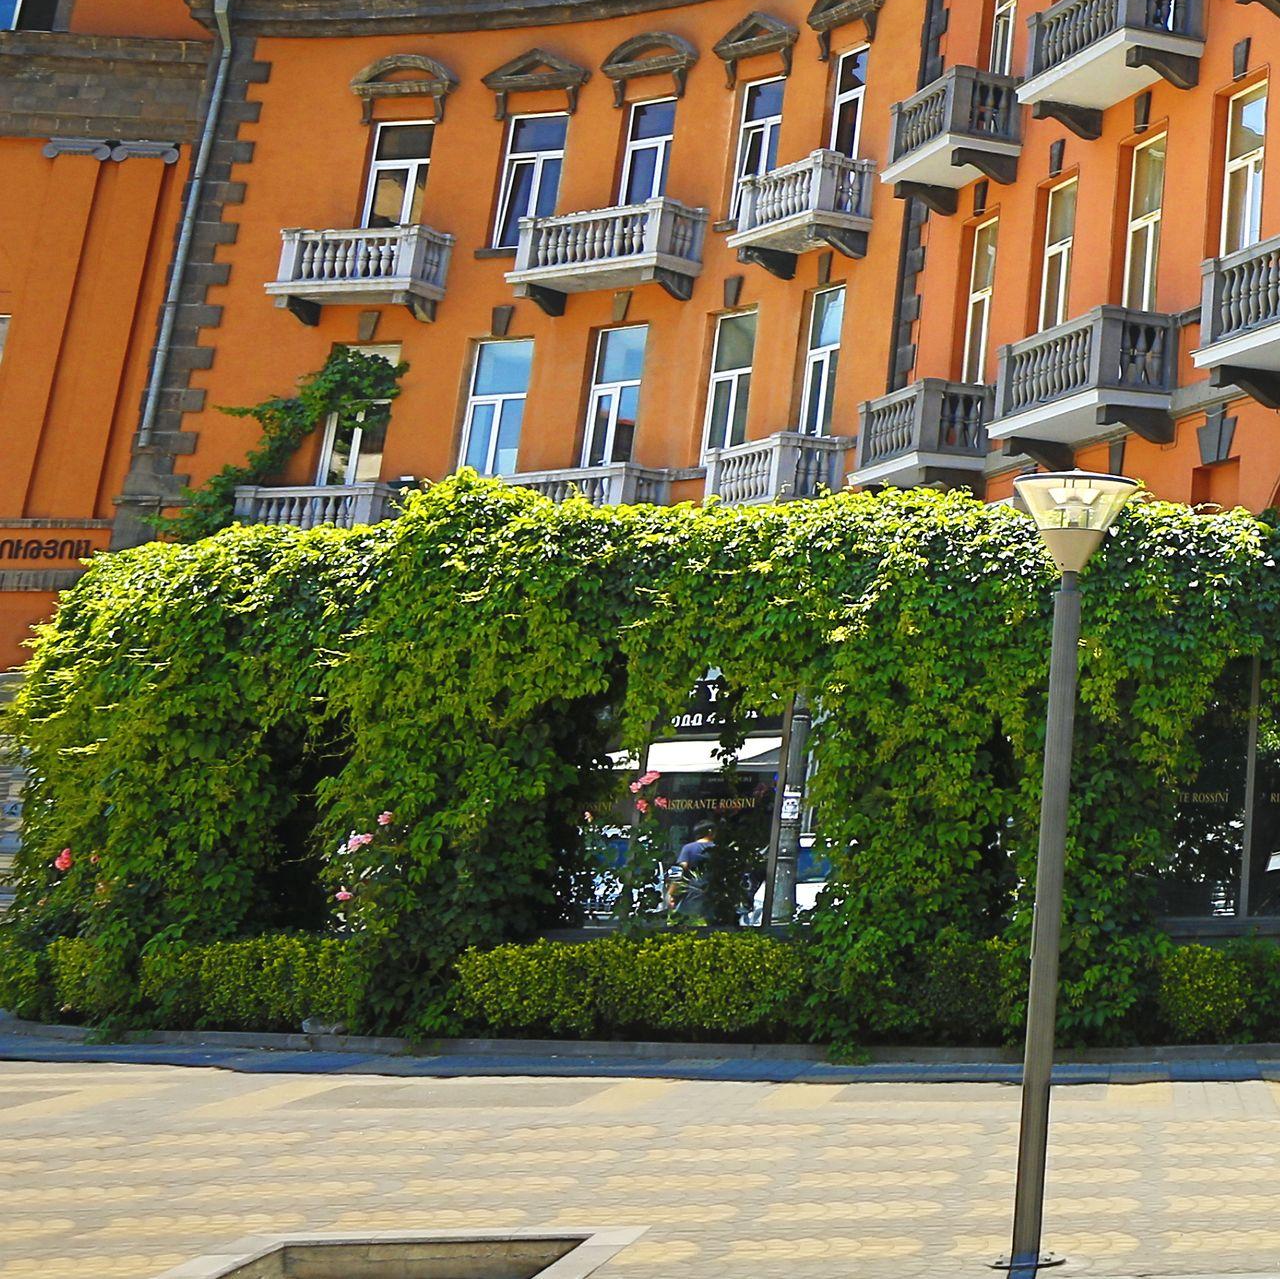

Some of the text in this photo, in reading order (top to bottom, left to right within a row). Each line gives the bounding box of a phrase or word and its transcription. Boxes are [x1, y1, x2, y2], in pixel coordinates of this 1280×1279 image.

[1192, 792, 1230, 803] ROSSINI
[665, 797, 756, 811] ISTORANTE ROSSINI
